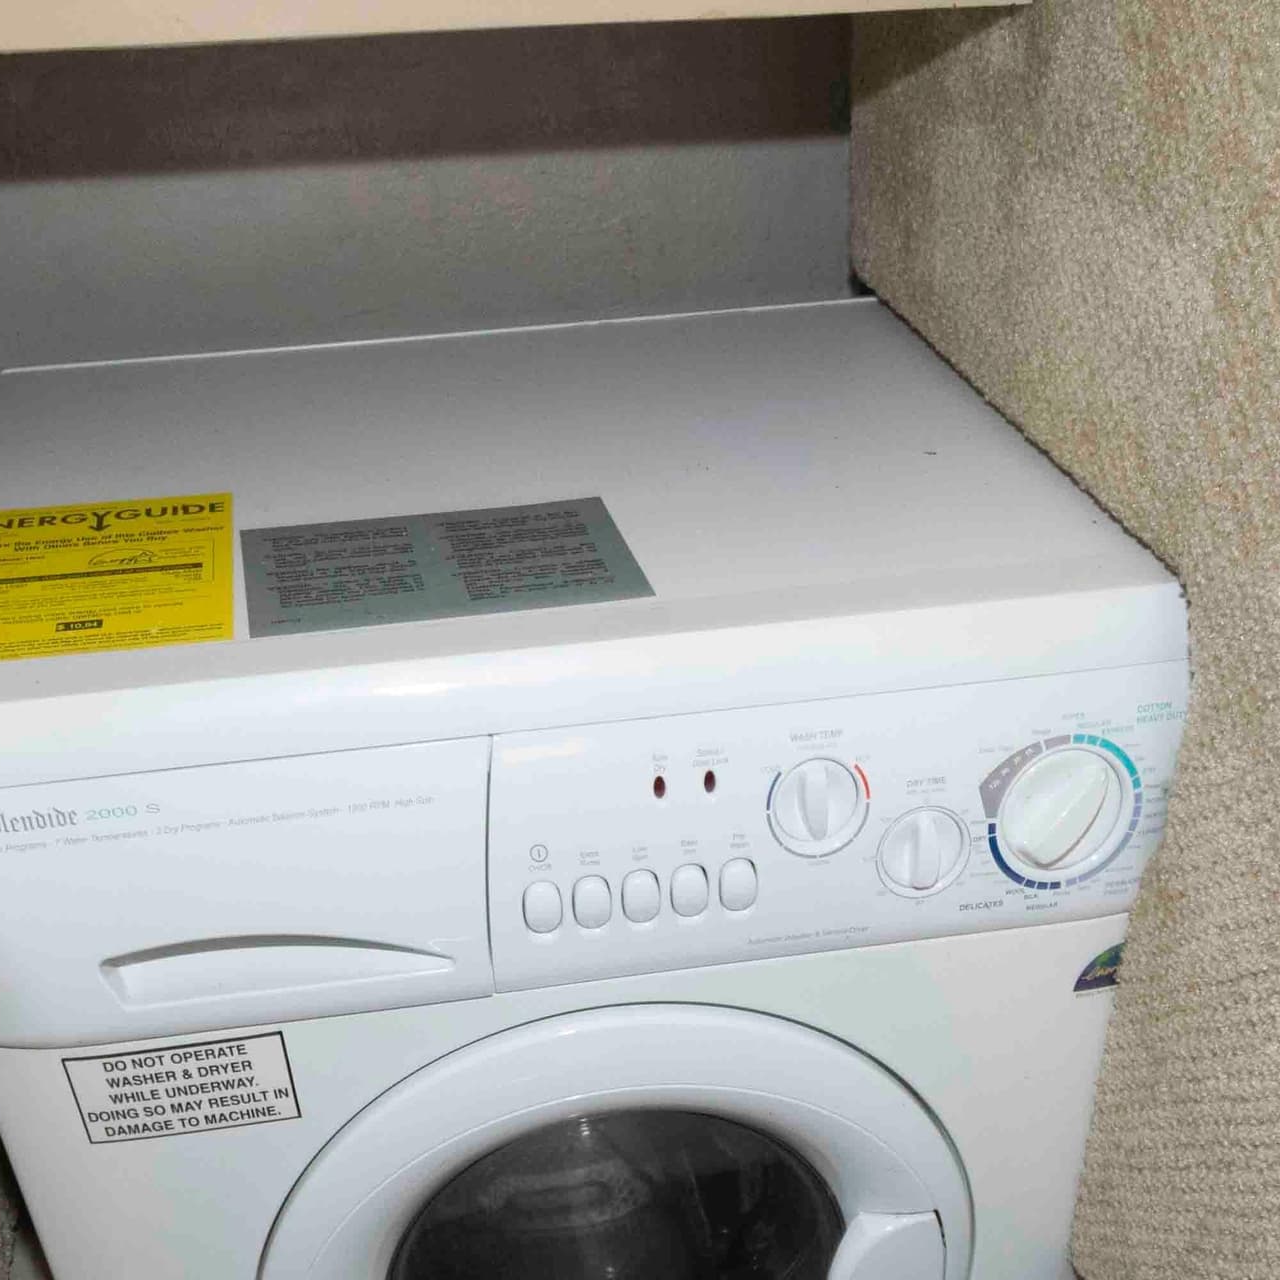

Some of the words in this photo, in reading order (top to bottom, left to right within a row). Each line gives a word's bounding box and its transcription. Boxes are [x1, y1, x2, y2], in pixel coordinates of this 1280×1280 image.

[85, 805, 138, 821] 2000
[145, 803, 161, 815] S
[959, 900, 1004, 912] DELICATES
[102, 1060, 127, 1073] DO
[131, 1055, 166, 1070] NOT
[170, 1044, 248, 1065] OPERATE
[105, 1071, 177, 1090] WASHER
[182, 1069, 193, 1080] &
[198, 1060, 254, 1078] DRYER
[87, 1108, 140, 1123] DOING
[143, 1104, 167, 1117] SO
[170, 1100, 204, 1115] MAY
[208, 1090, 270, 1109] RESULT
[274, 1087, 290, 1100] IN
[108, 1086, 161, 1105] WHILE
[165, 1076, 260, 1099] UNDERWAY.
[104, 1120, 175, 1138] DAMAGE
[178, 1116, 200, 1129] TO
[204, 1105, 282, 1126] MACHINE.
